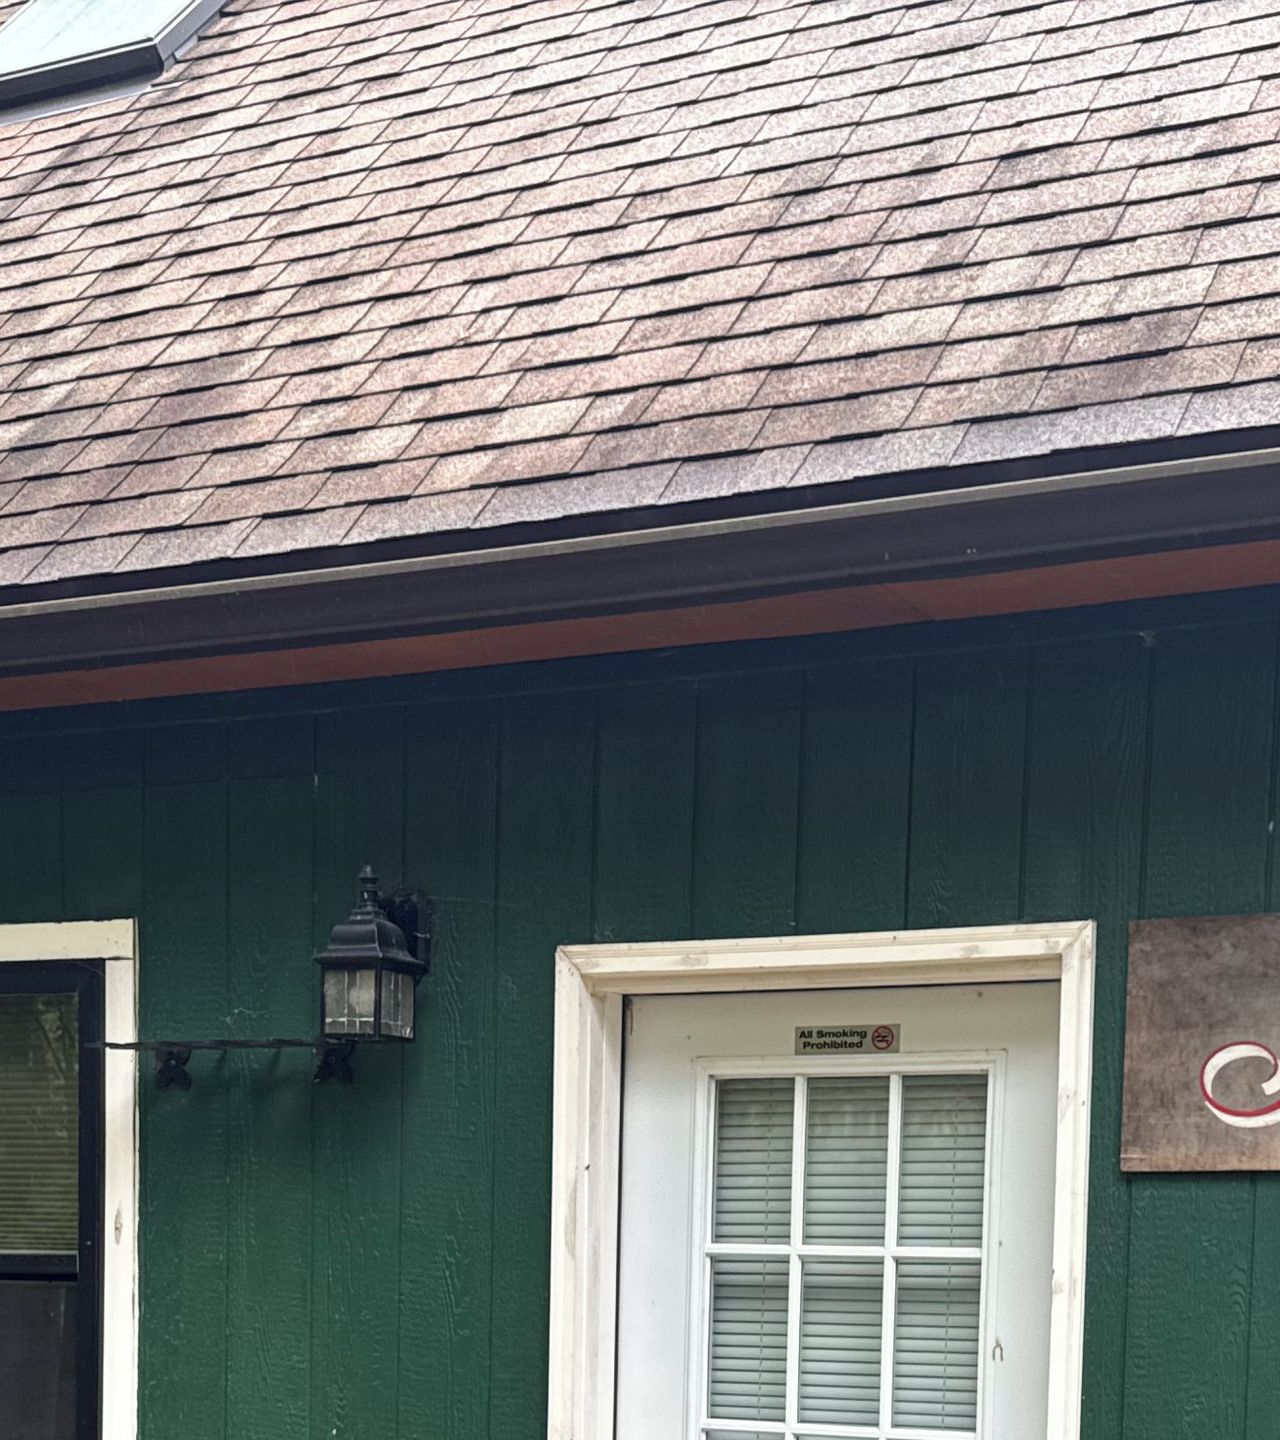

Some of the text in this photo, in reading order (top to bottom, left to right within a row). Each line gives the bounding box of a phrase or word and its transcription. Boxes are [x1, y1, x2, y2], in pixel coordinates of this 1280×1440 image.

[799, 1029, 867, 1039] All Smoking
[803, 1040, 863, 1050] Prohibited
